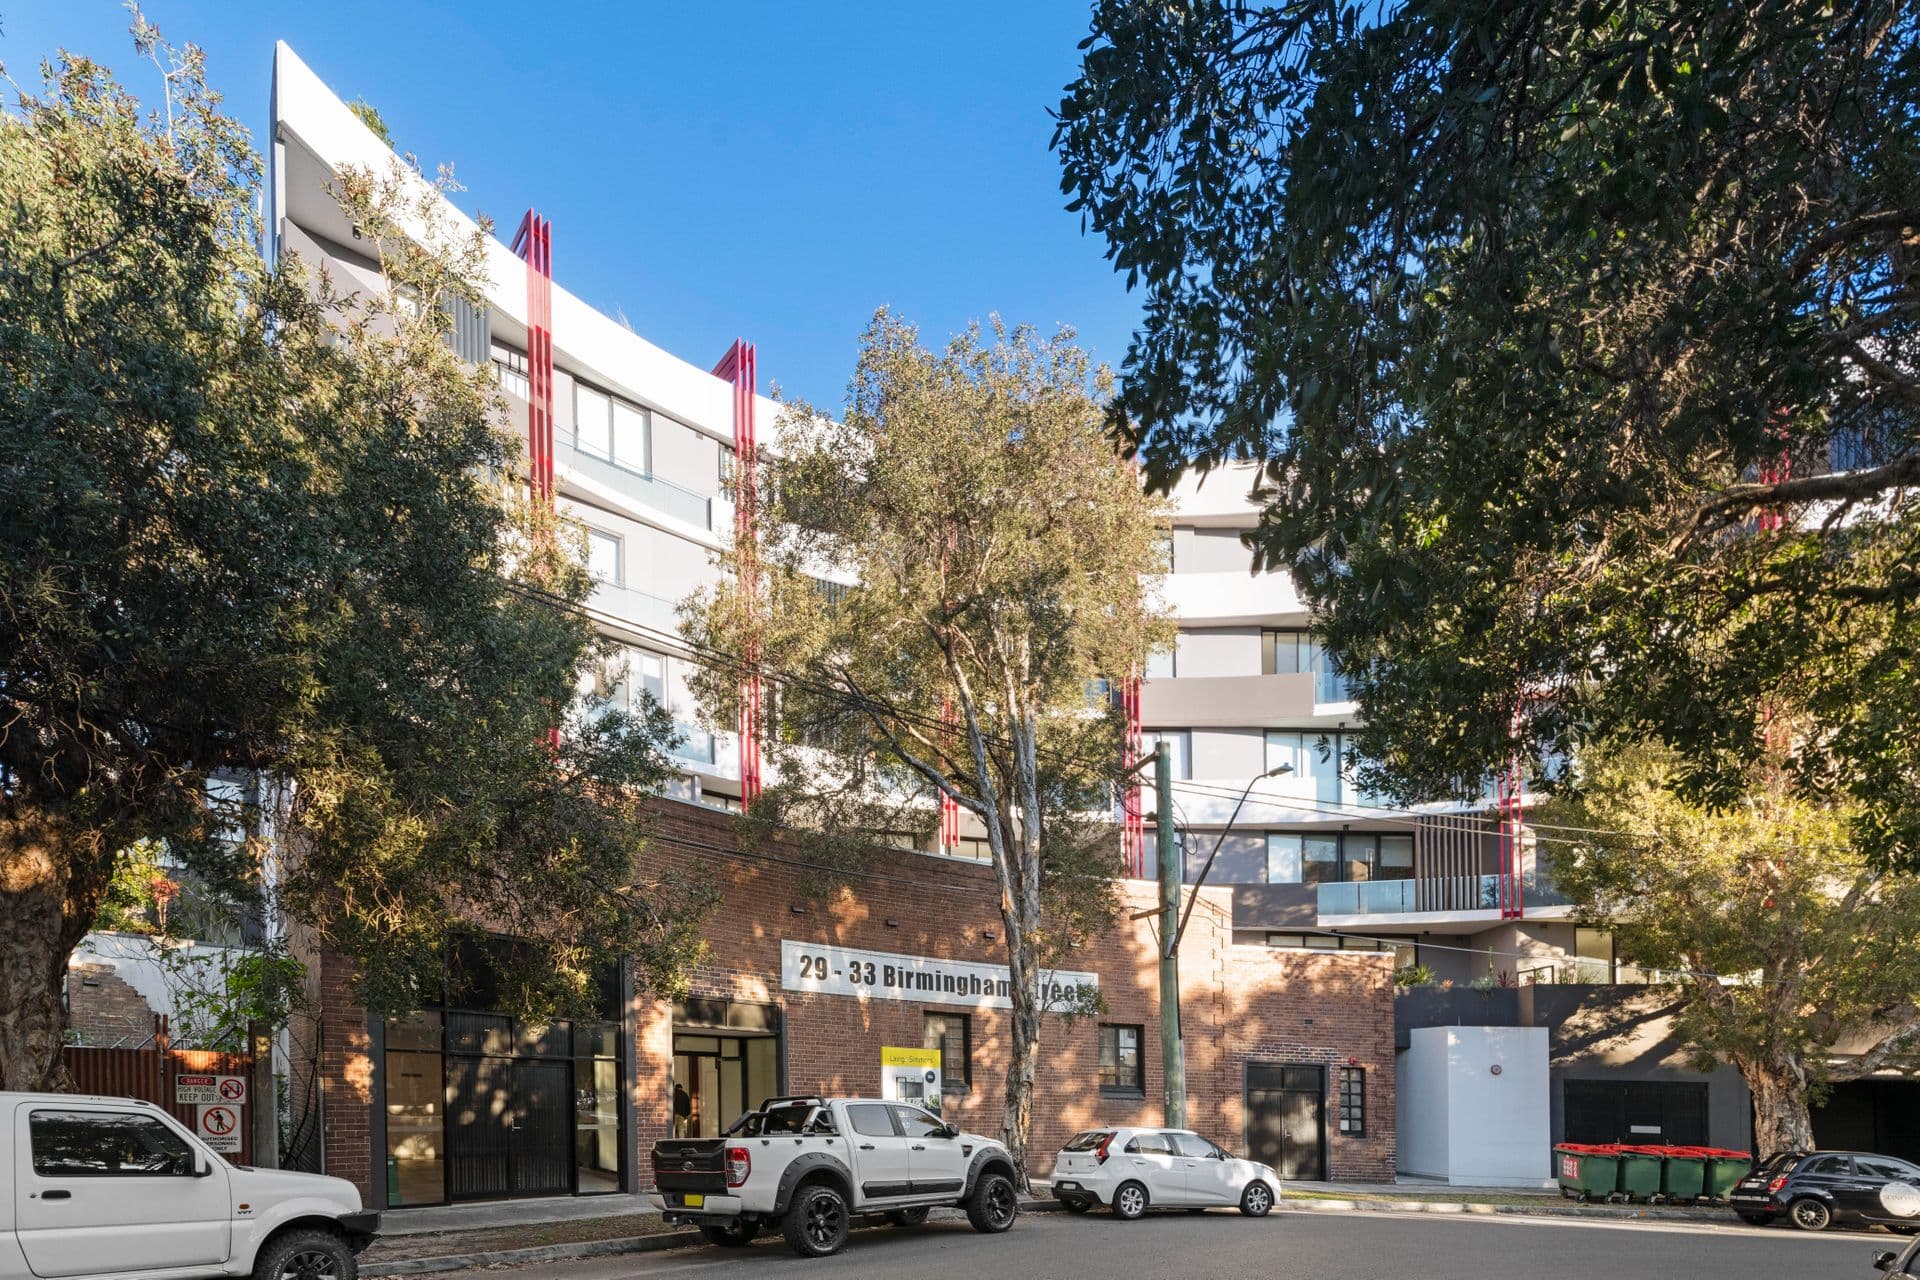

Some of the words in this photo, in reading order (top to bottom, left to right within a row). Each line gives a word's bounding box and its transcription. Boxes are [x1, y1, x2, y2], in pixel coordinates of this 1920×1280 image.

[799, 954, 828, 981] 29
[849, 960, 876, 986] 33
[883, 964, 1013, 997] Birmingham
[179, 1093, 198, 1102] KEEP
[201, 1094, 216, 1102] OUT
